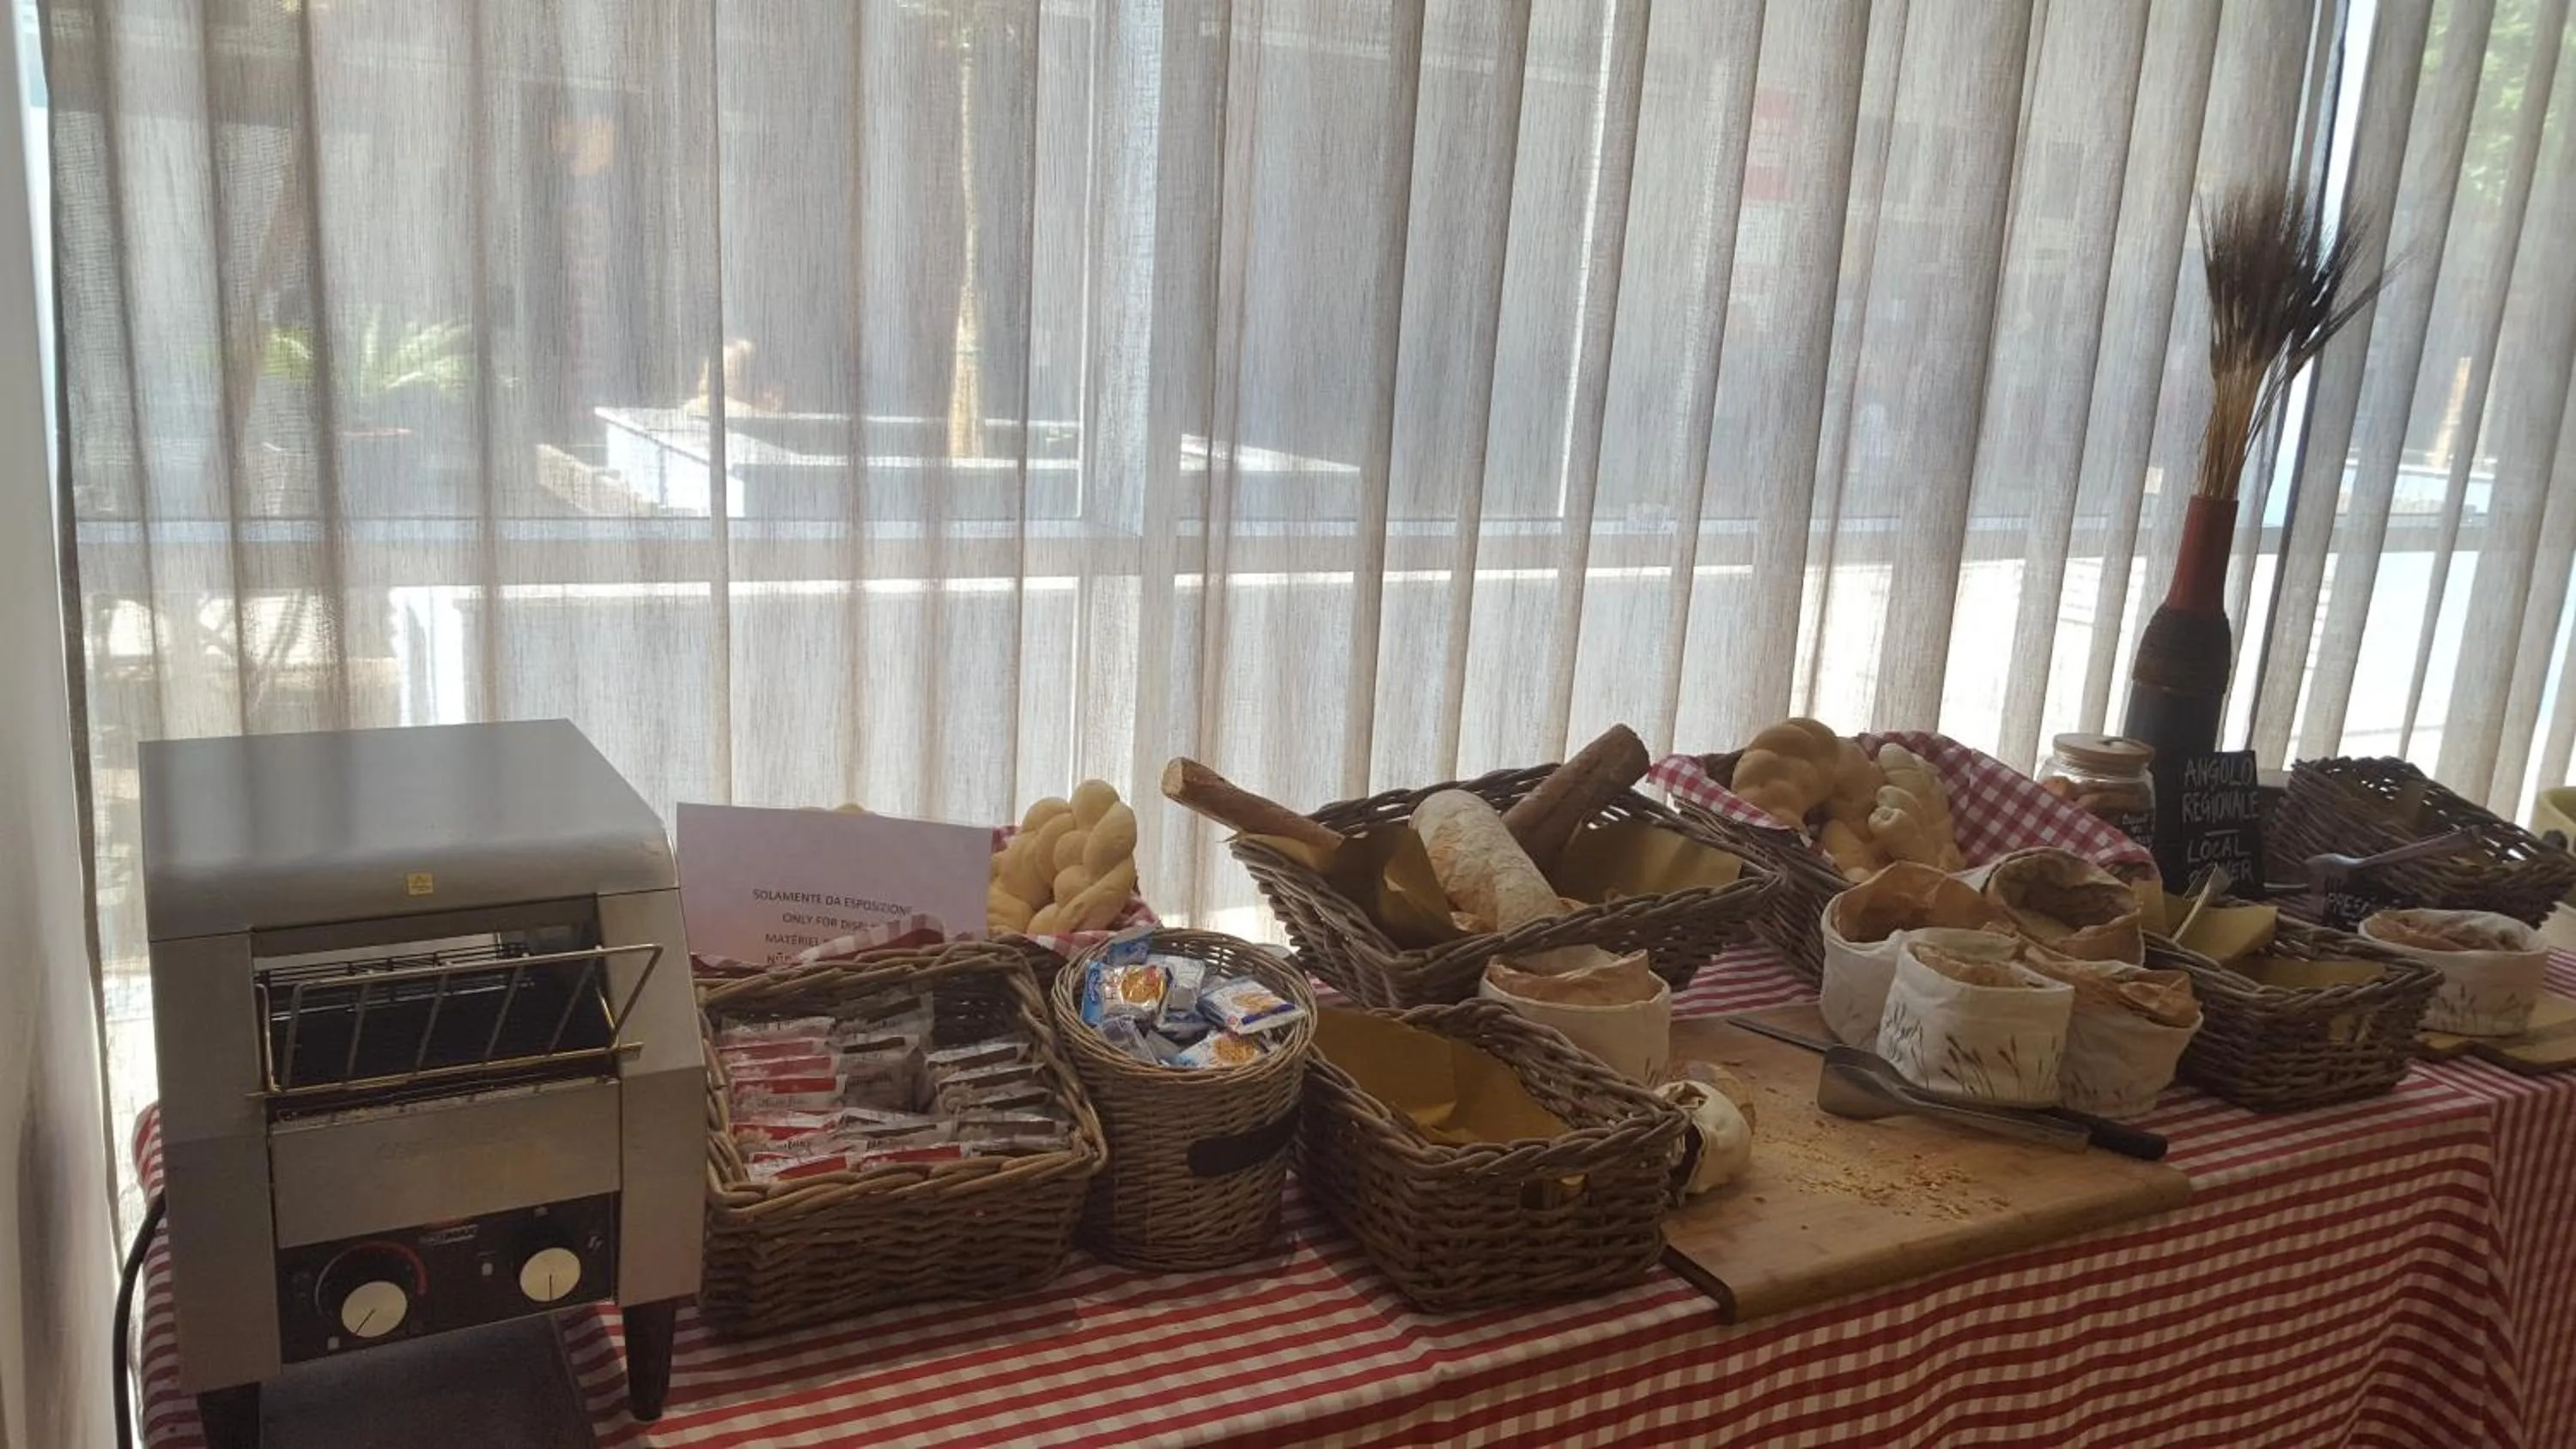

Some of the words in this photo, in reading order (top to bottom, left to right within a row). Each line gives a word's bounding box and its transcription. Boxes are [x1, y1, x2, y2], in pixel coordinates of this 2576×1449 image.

[2184, 756, 2255, 790] ANGOLO
[2182, 791, 2260, 824] REGIONALE
[2187, 837, 2251, 863] LOCAL
[753, 888, 822, 904] SOLAMENTE
[825, 894, 841, 906] DA
[782, 912, 813, 925] ONLY
[815, 916, 837, 928] FOR
